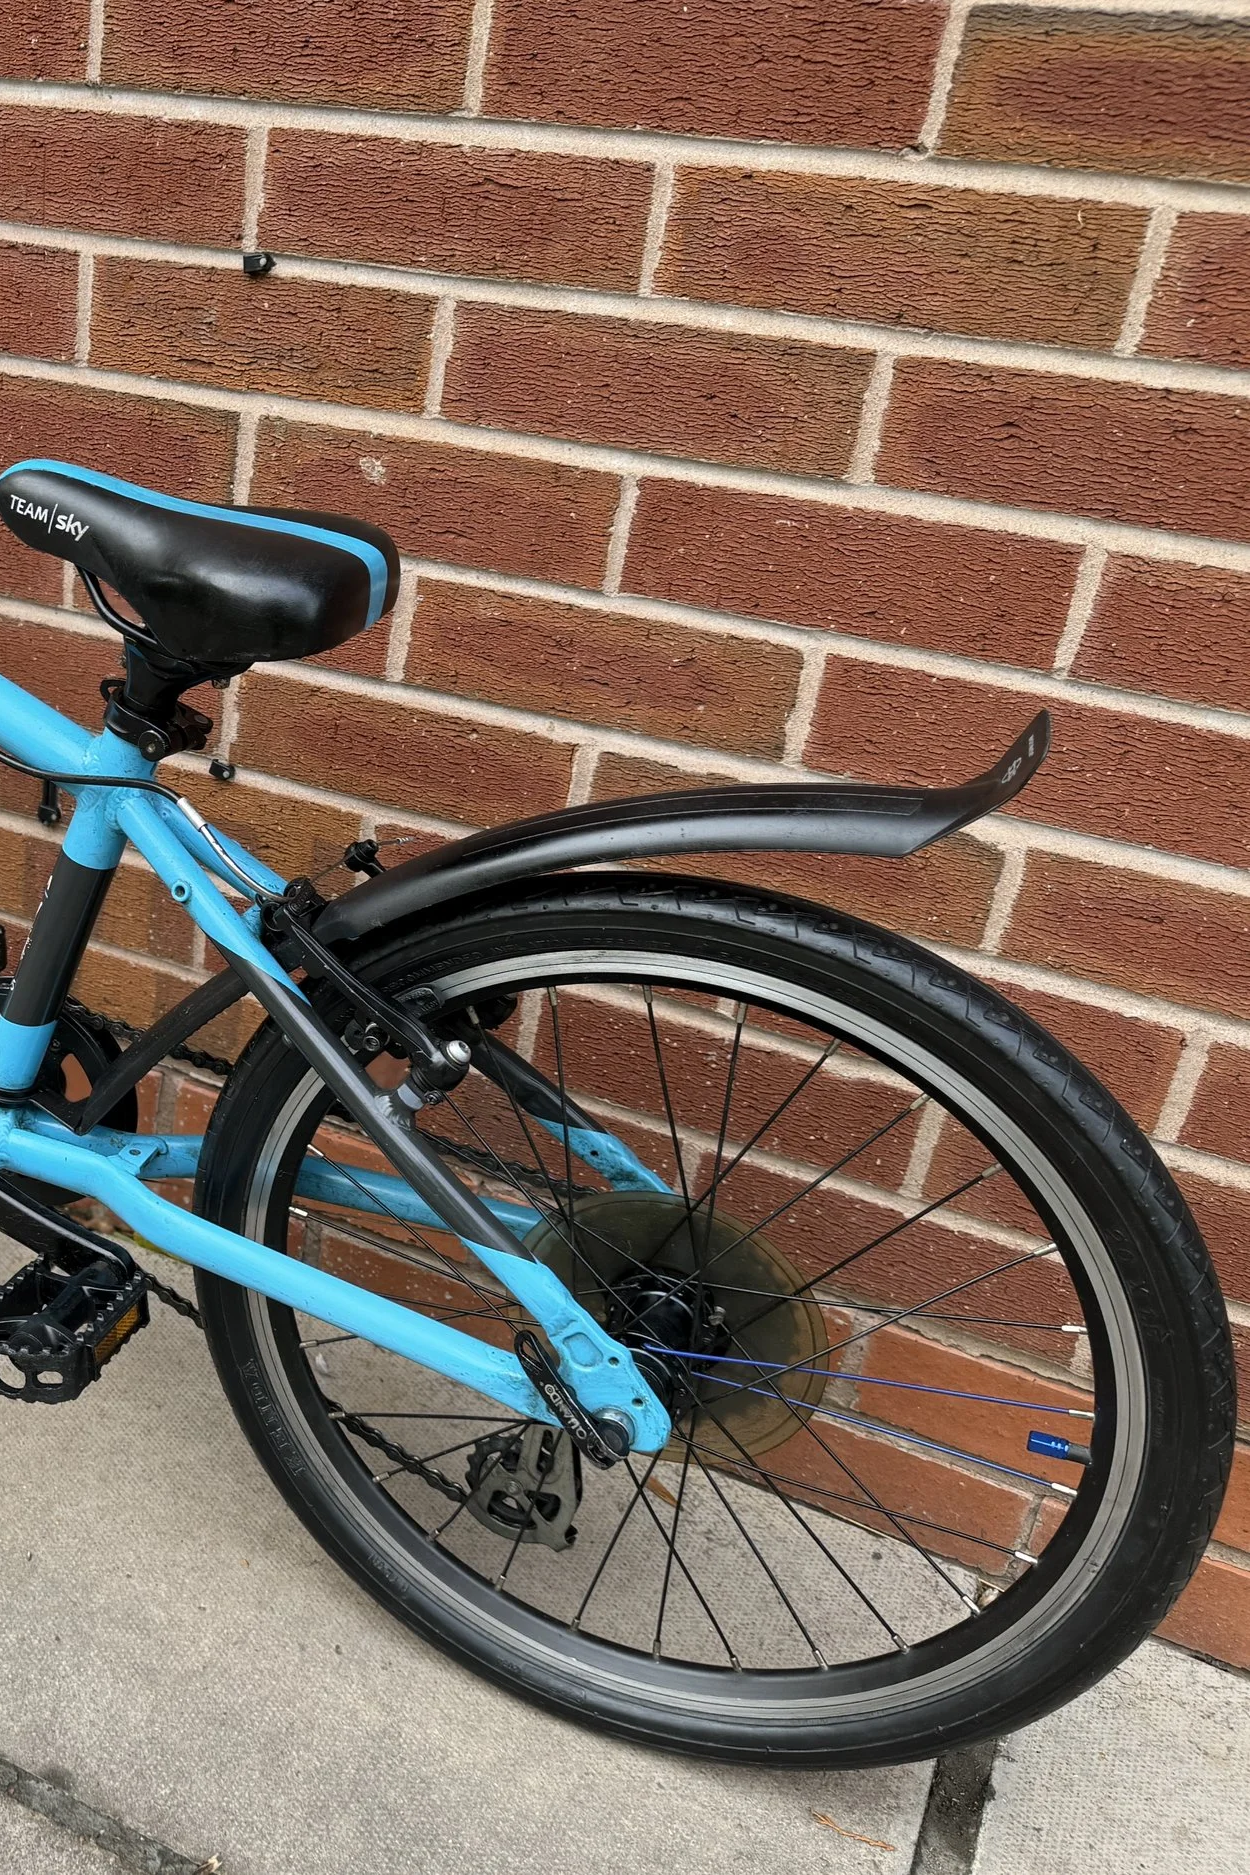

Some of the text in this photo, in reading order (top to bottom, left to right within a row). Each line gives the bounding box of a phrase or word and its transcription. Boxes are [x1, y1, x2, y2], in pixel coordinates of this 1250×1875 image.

[10, 494, 90, 542] TEAM sky
[241, 1357, 307, 1478] KENDA
[543, 1382, 588, 1440] QUANDO
